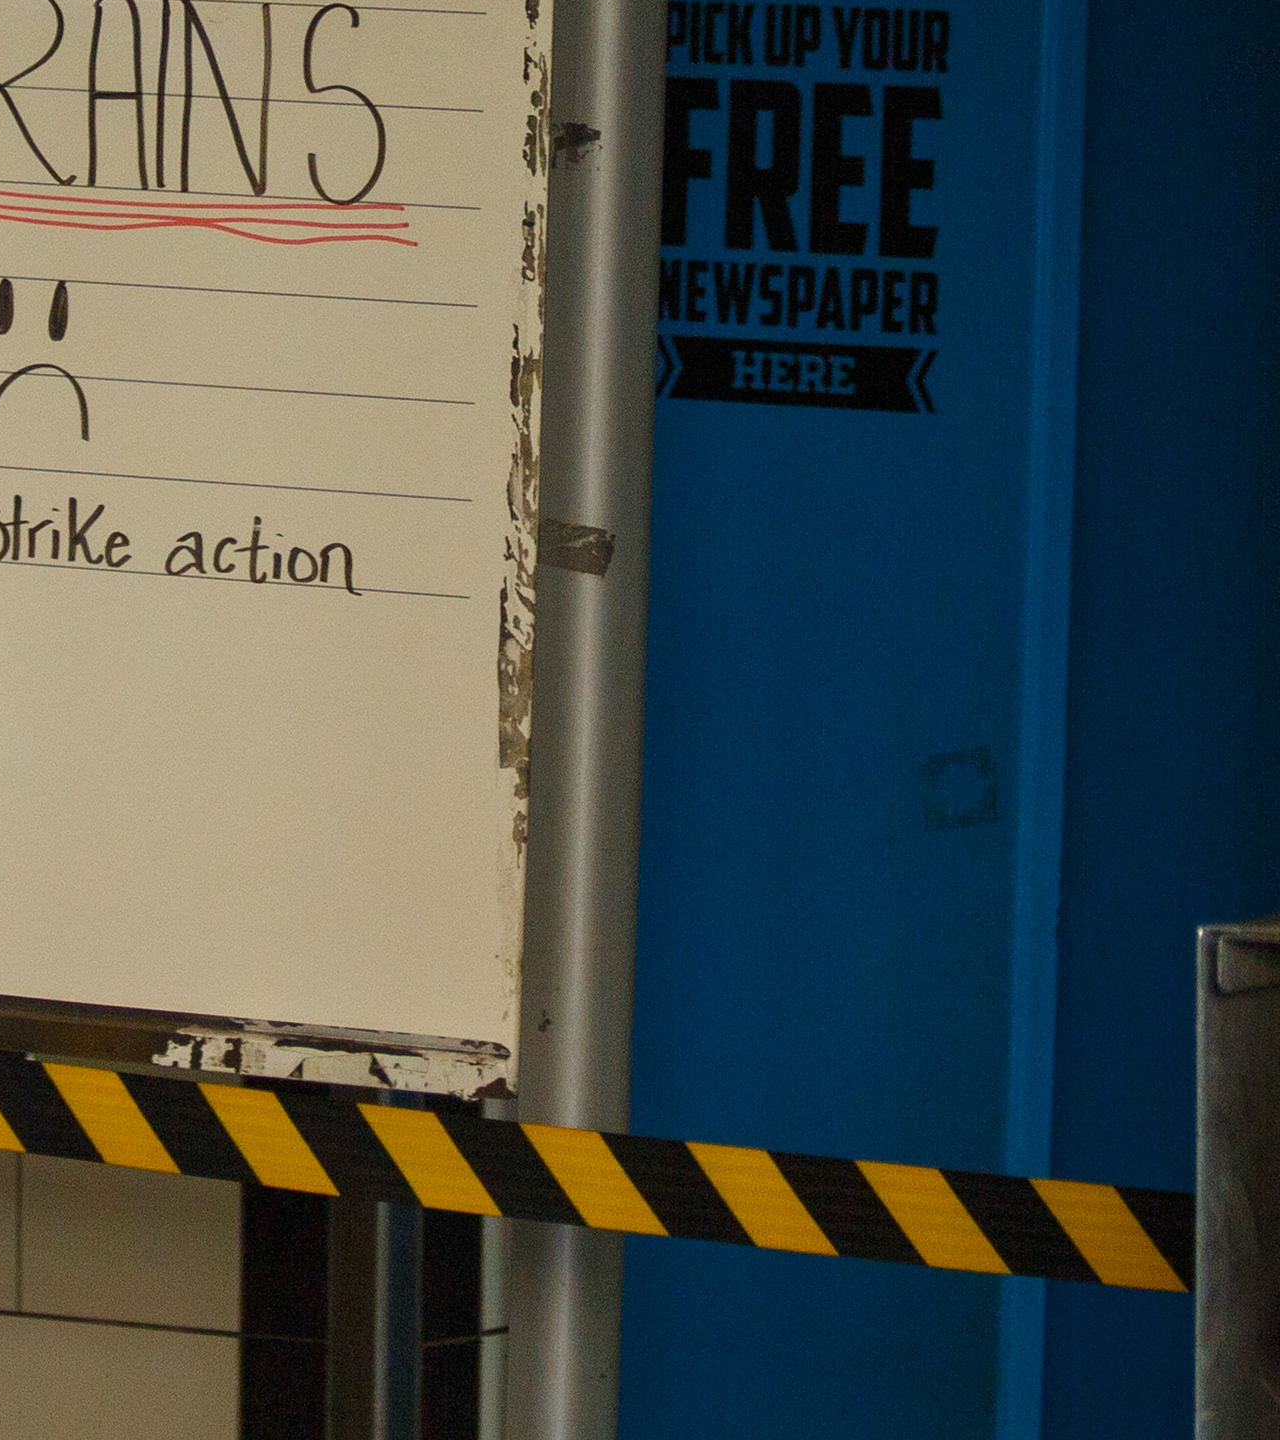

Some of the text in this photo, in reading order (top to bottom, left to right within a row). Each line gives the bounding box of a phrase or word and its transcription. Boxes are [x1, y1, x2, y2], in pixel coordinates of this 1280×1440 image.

[667, 0, 950, 74] PICK UP YOUR
[660, 75, 944, 259] FREE
[658, 259, 938, 335] NEWSPAPER
[732, 351, 856, 395] HERE
[164, 516, 363, 596] action
